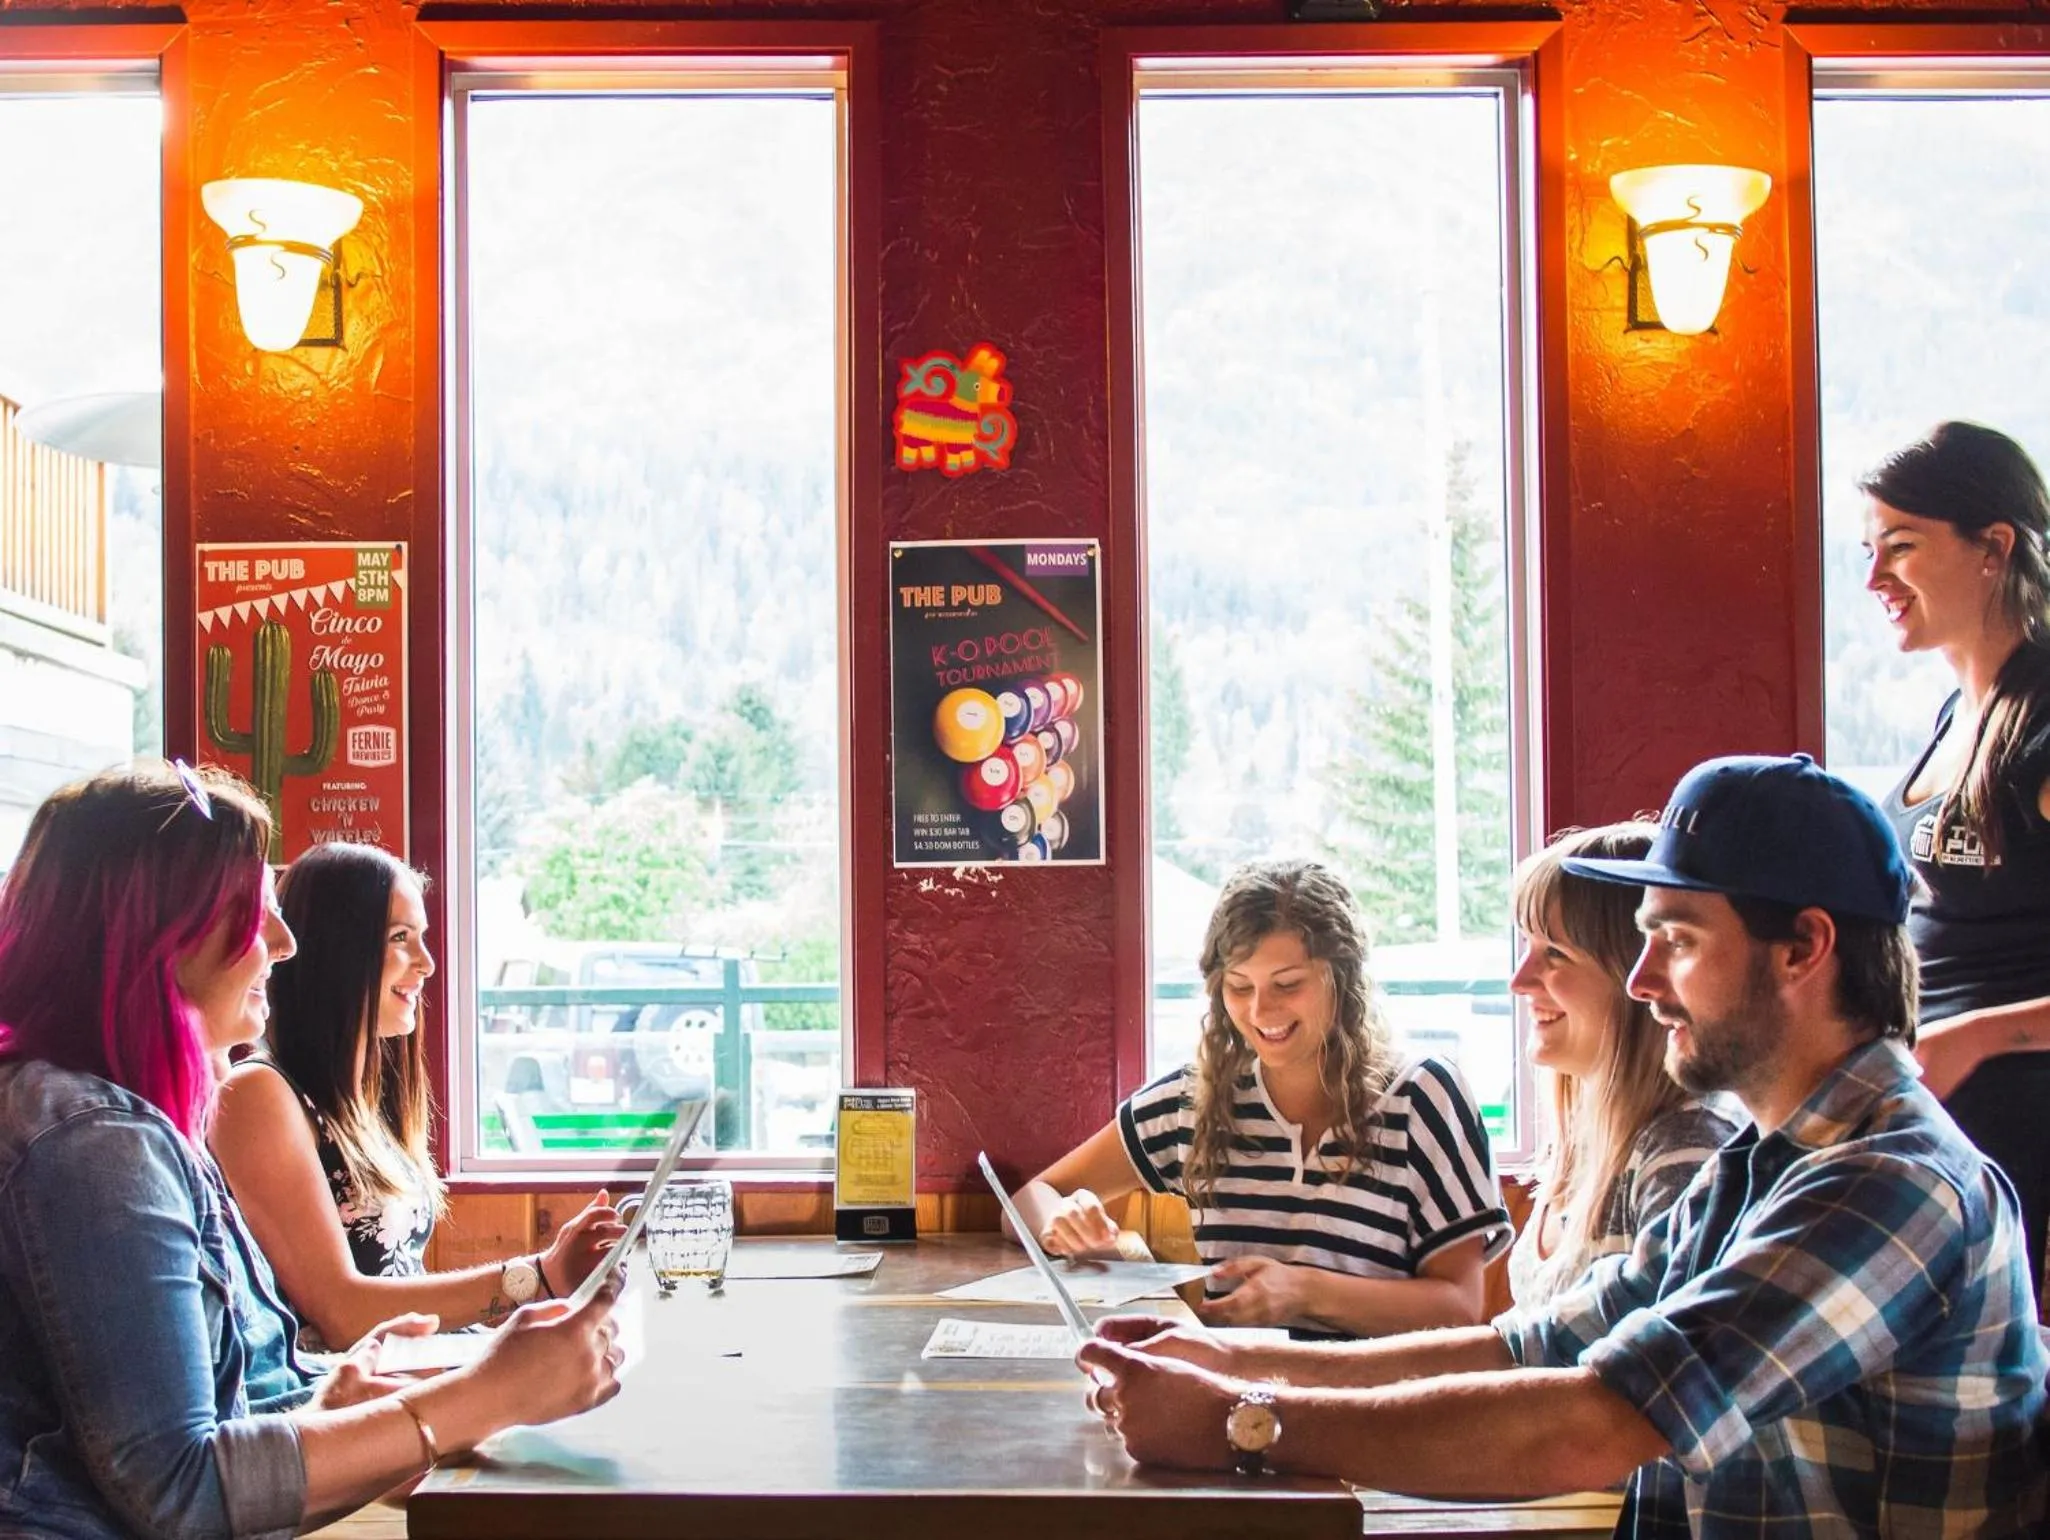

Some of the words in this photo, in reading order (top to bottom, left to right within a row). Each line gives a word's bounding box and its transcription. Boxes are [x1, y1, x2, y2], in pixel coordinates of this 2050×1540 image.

[357, 552, 389, 566] MAY
[1027, 552, 1087, 566] MONDAYS
[204, 560, 249, 582] THE
[254, 558, 305, 581] PUB
[358, 570, 389, 586] 5TH
[358, 588, 389, 602] 8PM
[900, 586, 945, 608] THE
[951, 584, 1002, 606] PUB
[309, 607, 383, 635] Cinco
[308, 645, 385, 675] Mayo
[936, 653, 1059, 687] TOURNAMENT
[342, 675, 390, 696] Trivia
[352, 731, 392, 750] FERNIE
[322, 782, 367, 790] FEATURING
[310, 797, 380, 812] CHICKEN
[952, 840, 980, 850] BOTTLES
